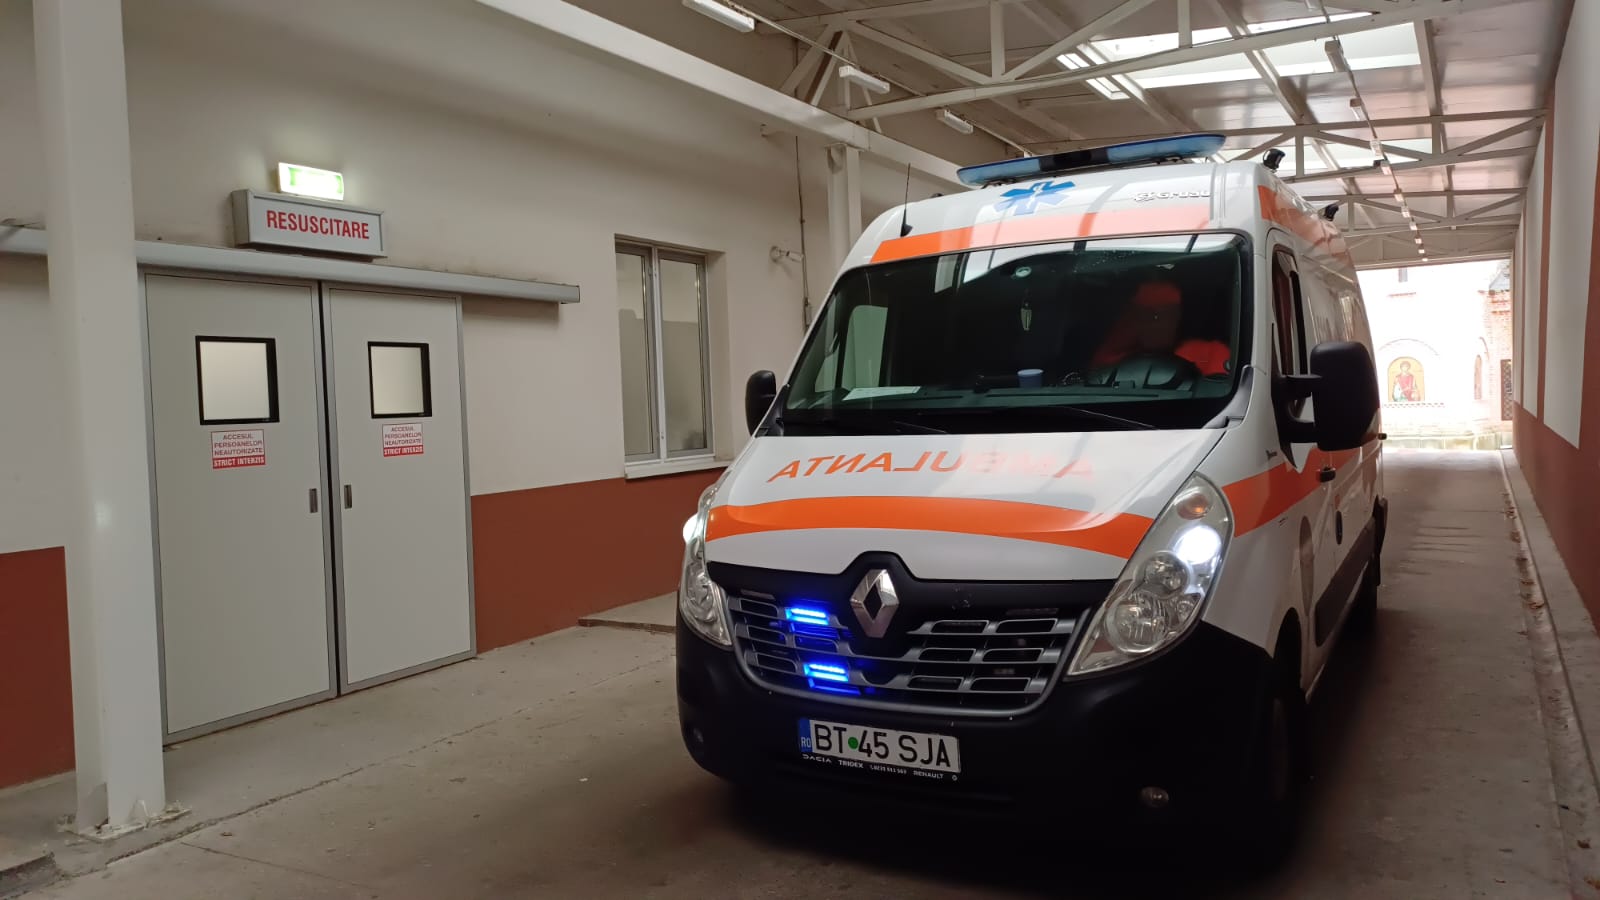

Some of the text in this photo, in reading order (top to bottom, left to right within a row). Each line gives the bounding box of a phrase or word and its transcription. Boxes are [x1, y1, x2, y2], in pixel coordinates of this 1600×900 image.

[266, 209, 370, 240] RESUSCITARE
[214, 440, 263, 449] PERSOANELOR
[214, 447, 264, 456] NEAUTORIZATE
[213, 456, 265, 468] STRICT INTERZIS
[800, 736, 812, 748] RO
[814, 723, 951, 768] BT 45 SJA
[802, 753, 832, 764] DACIA
[838, 759, 864, 769] TRIDEX
[913, 770, 944, 780] RENAULT
